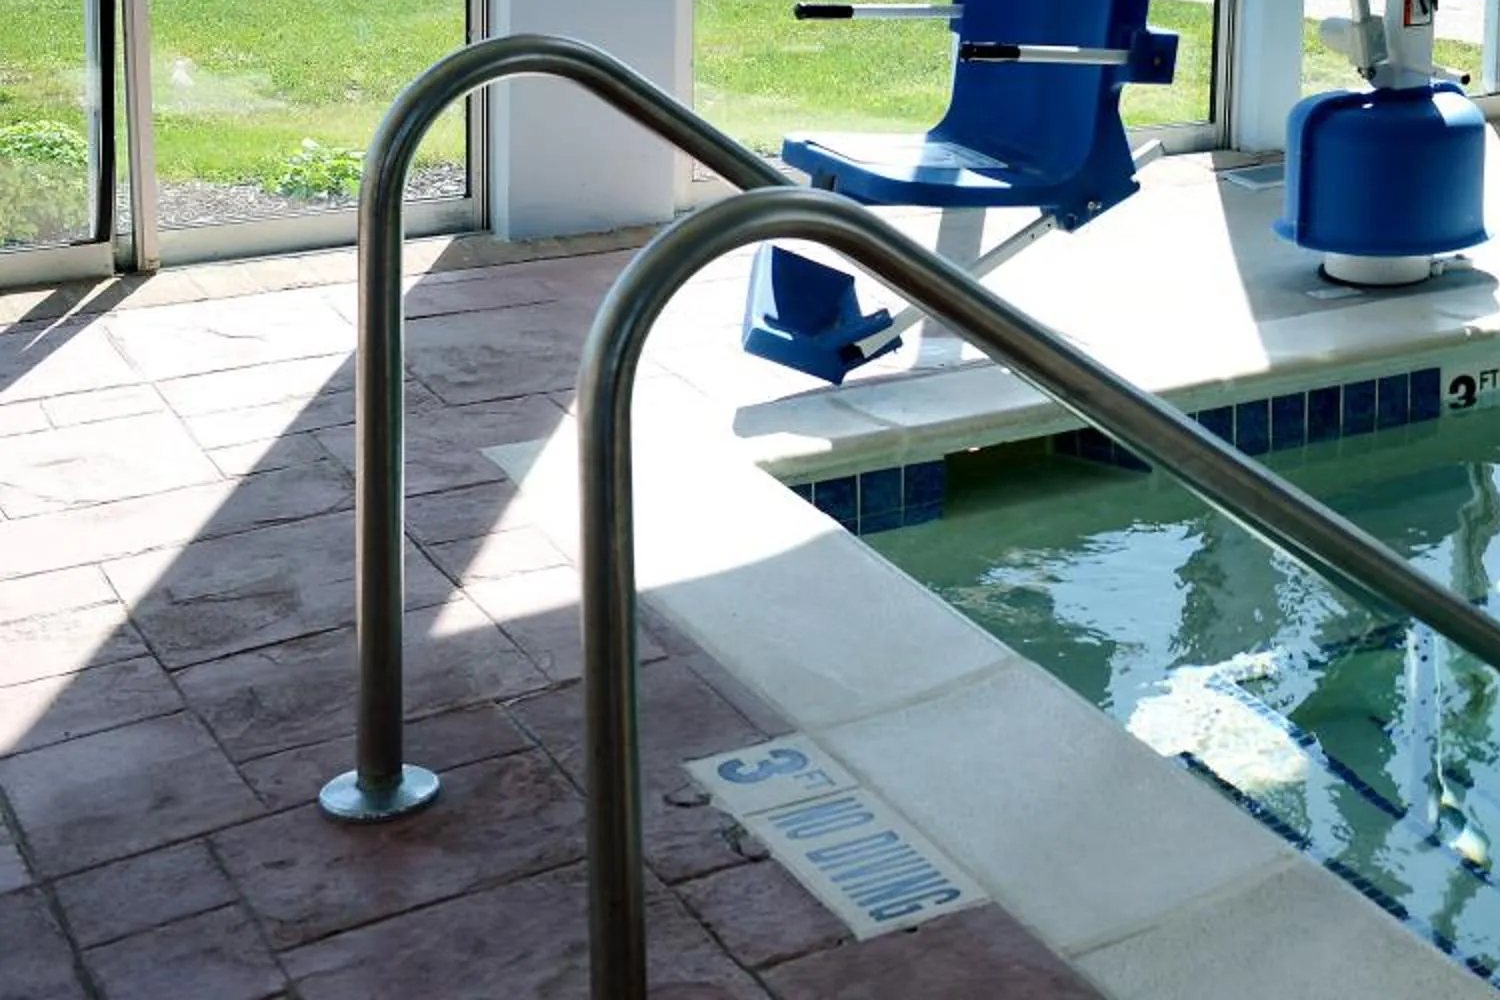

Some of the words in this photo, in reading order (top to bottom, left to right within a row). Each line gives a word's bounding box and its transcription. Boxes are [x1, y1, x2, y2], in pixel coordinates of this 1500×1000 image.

[1448, 374, 1477, 409] 3
[1479, 368, 1499, 391] FT
[717, 748, 809, 784] 3
[793, 769, 837, 790] FT
[767, 796, 875, 841] NO
[805, 829, 962, 923] DIVING
